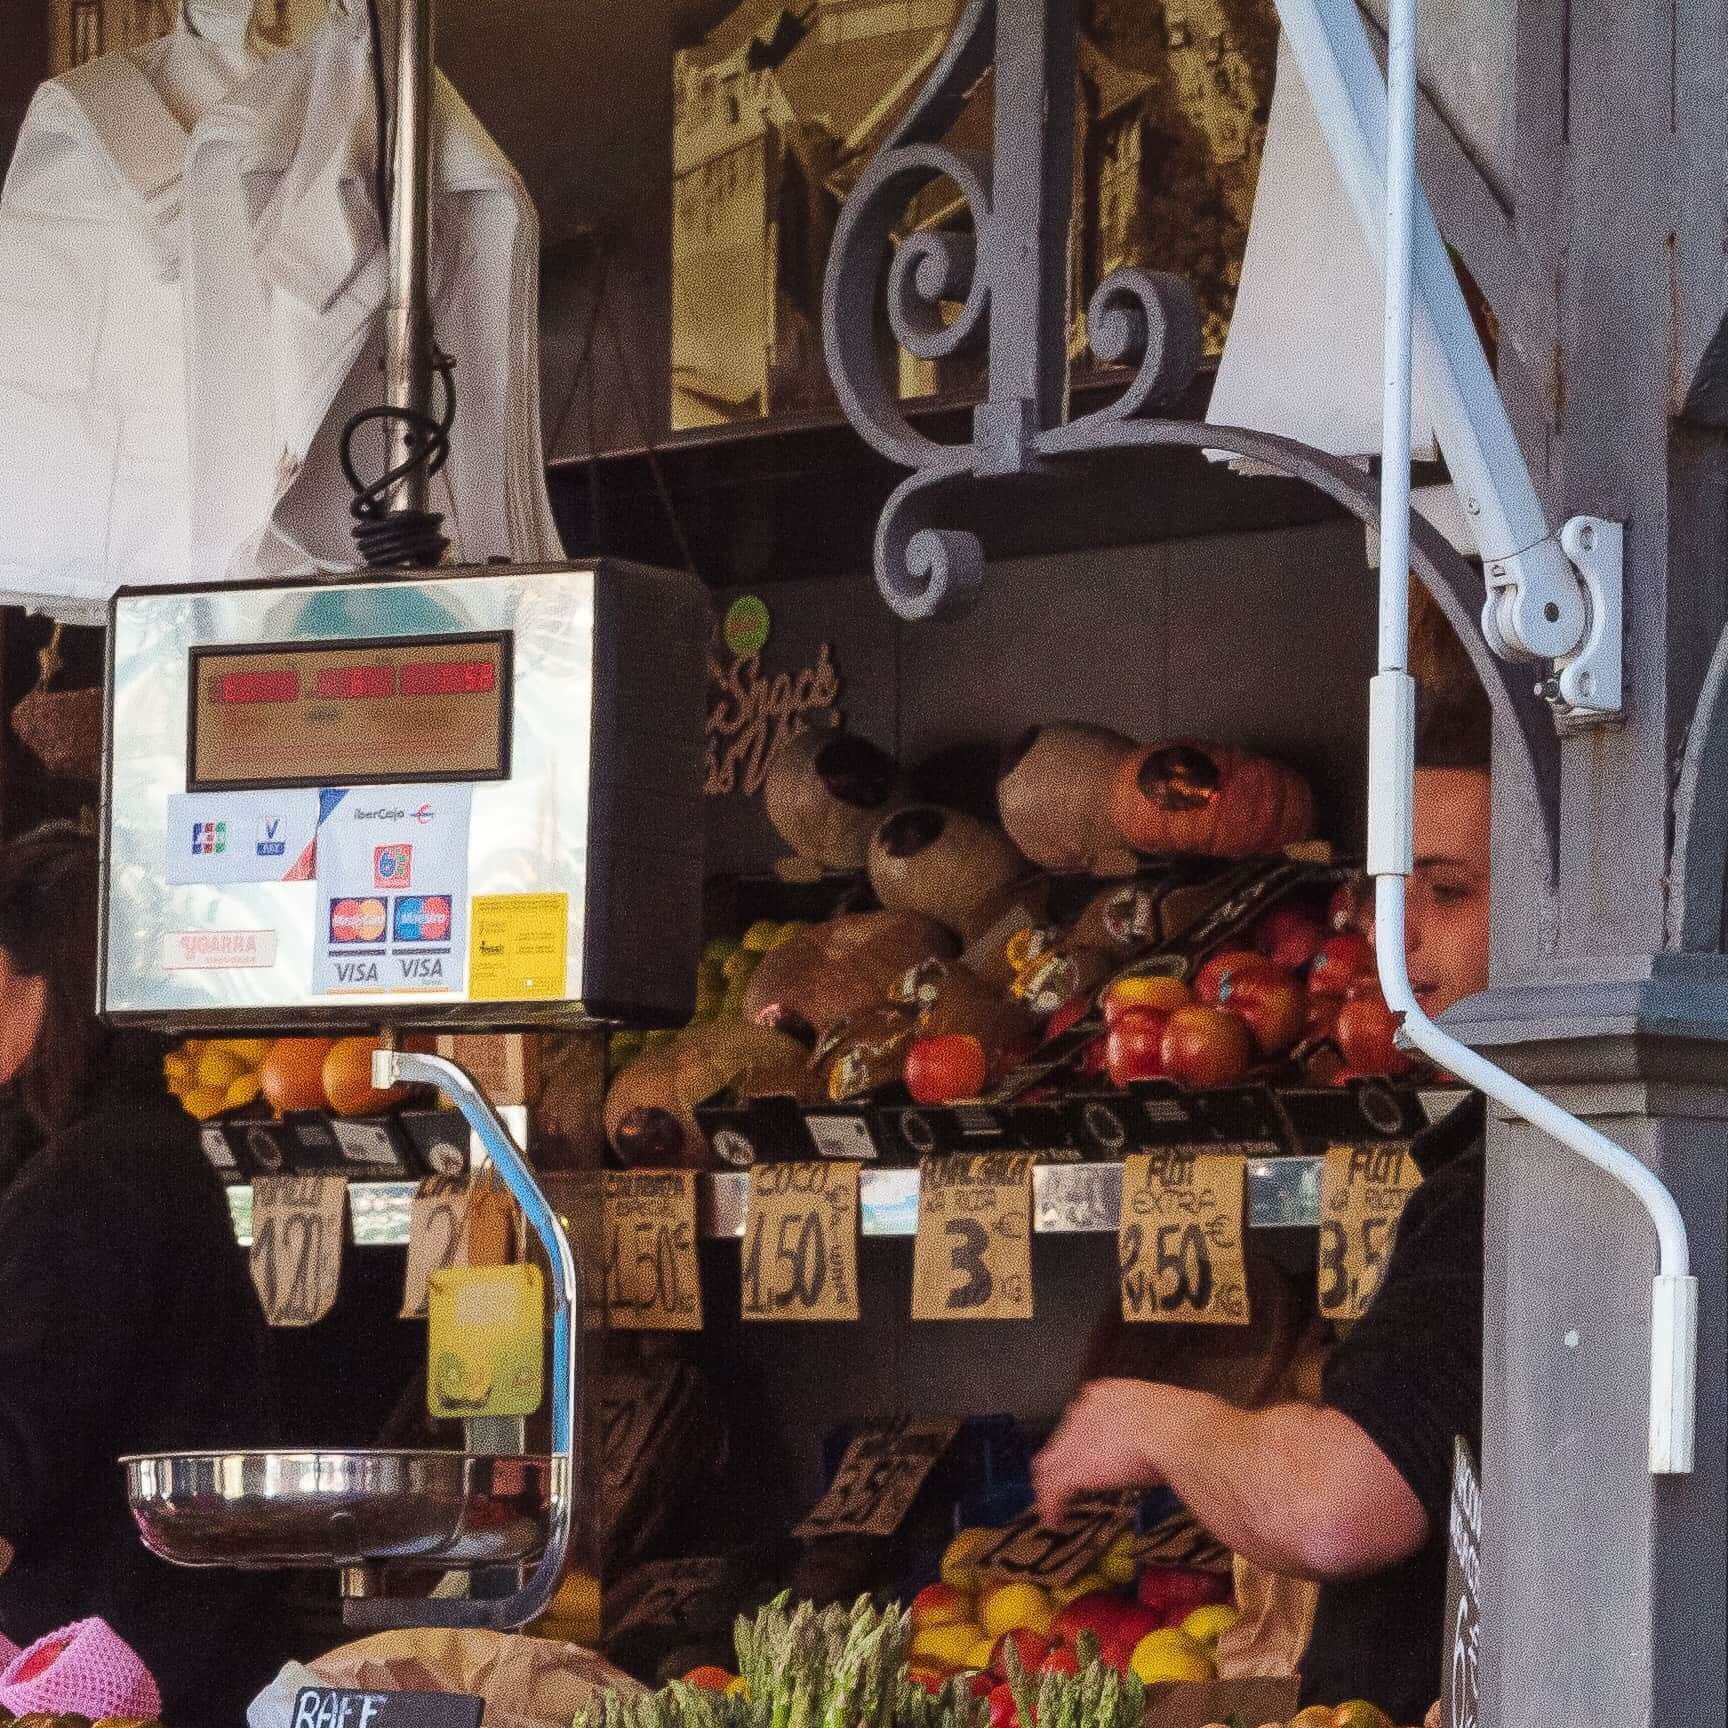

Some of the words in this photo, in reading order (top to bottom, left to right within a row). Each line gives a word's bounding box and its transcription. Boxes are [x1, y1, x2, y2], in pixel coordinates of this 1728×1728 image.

[335, 962, 379, 983] VISA
[399, 957, 443, 979] VISA
[944, 1217, 994, 1309] 3
